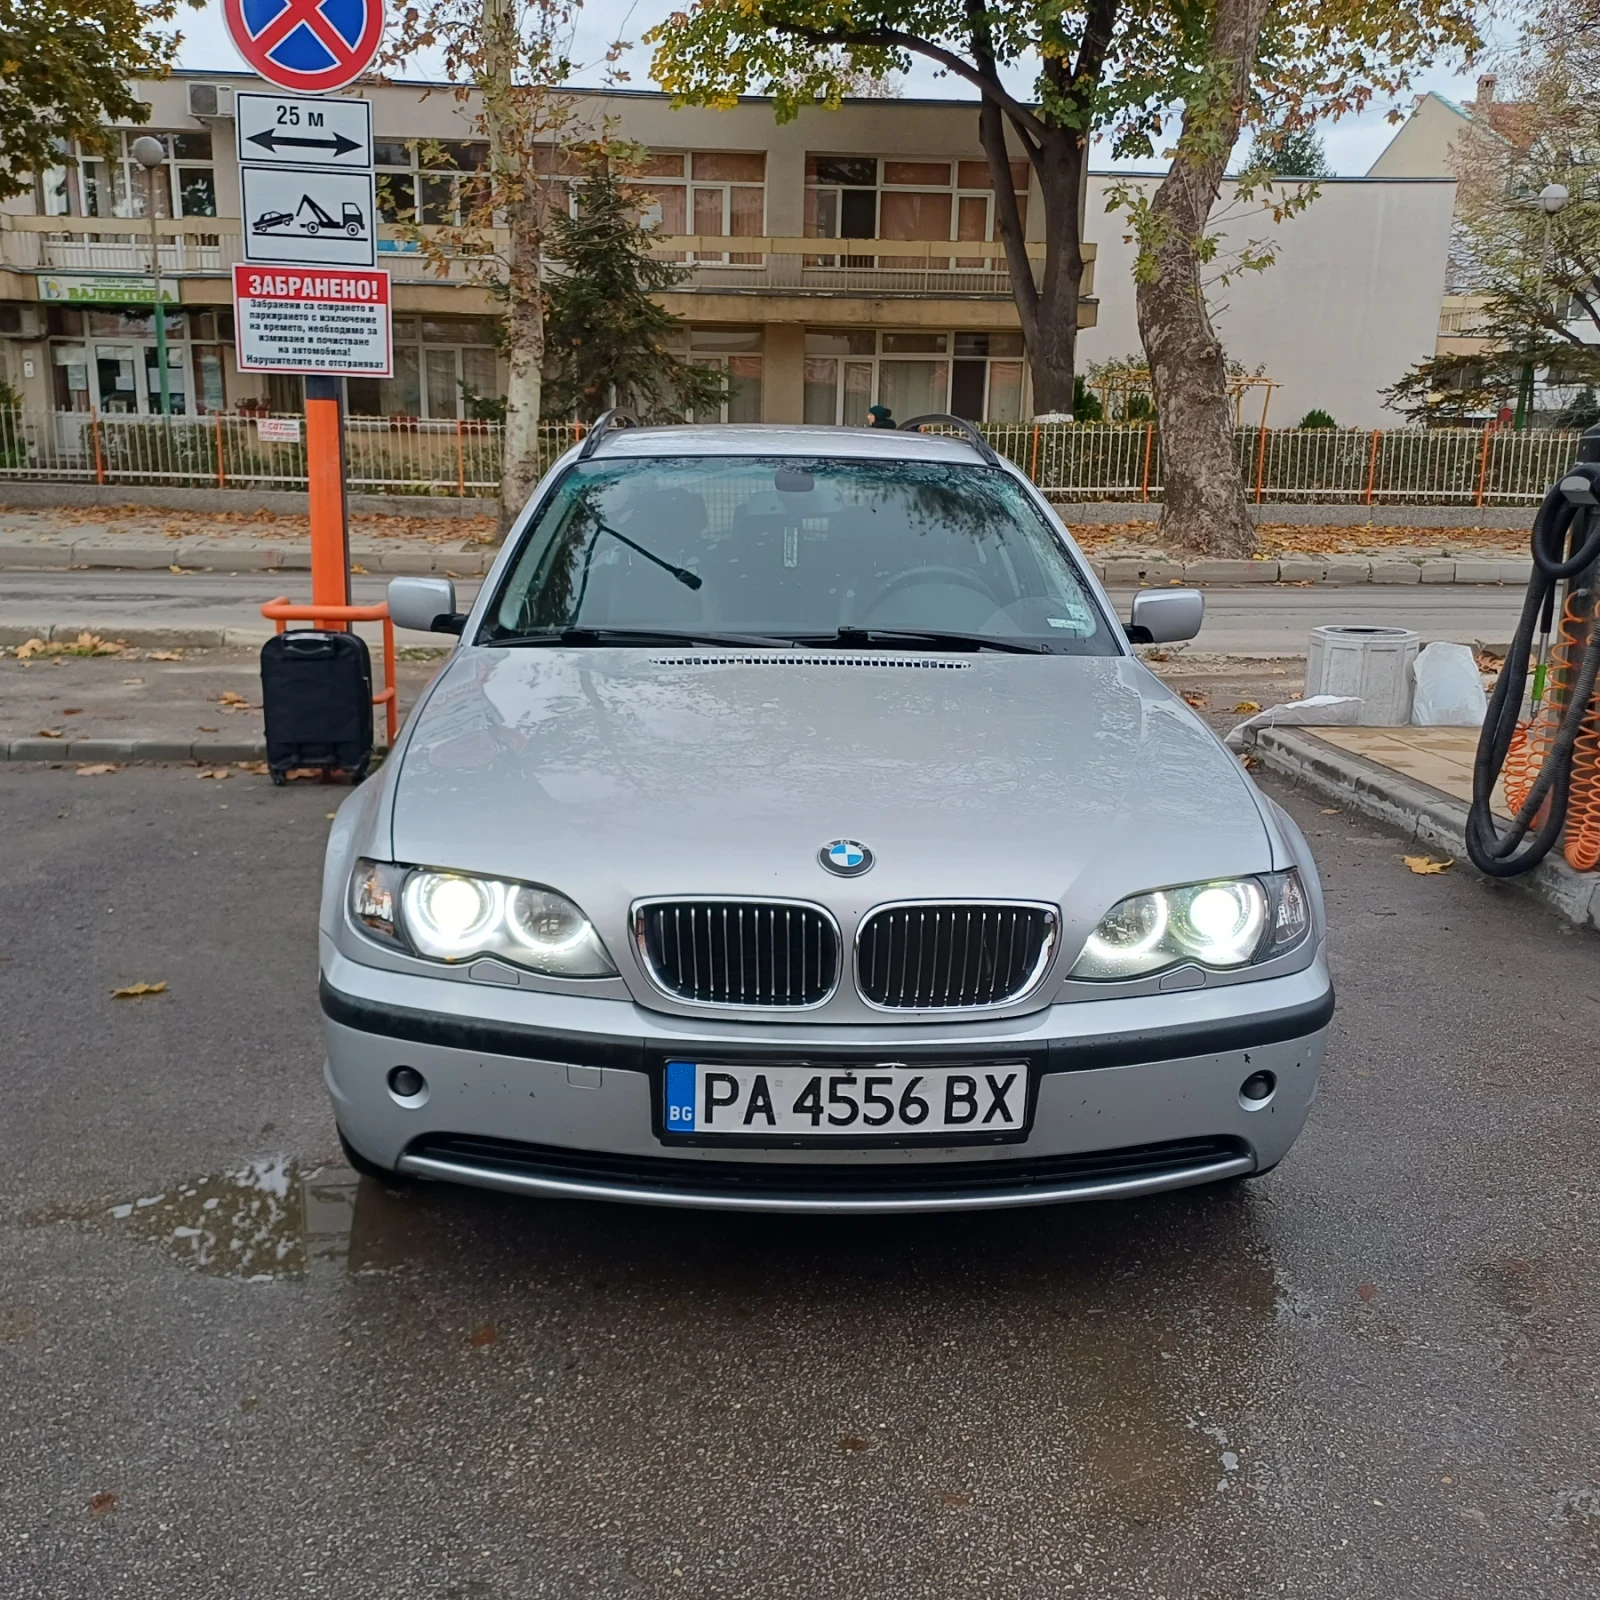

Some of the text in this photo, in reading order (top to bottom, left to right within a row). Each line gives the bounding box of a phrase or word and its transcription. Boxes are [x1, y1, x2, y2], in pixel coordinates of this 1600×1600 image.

[276, 105, 300, 126] 25
[249, 275, 378, 301] ЗАБРАНЕНО!
[250, 299, 301, 310] Забранени
[317, 303, 366, 313] спирането
[249, 312, 309, 322] паркирането
[319, 315, 377, 324] изключение
[263, 323, 306, 334] времето,
[308, 324, 365, 335] необходимо
[258, 334, 305, 343] измиване
[316, 337, 370, 346] почистване
[292, 347, 351, 356] автомобила!
[246, 354, 312, 366] Нарушителите
[328, 359, 384, 369] отстраняват
[669, 1072, 1018, 1127] BG PA 4556 BX
